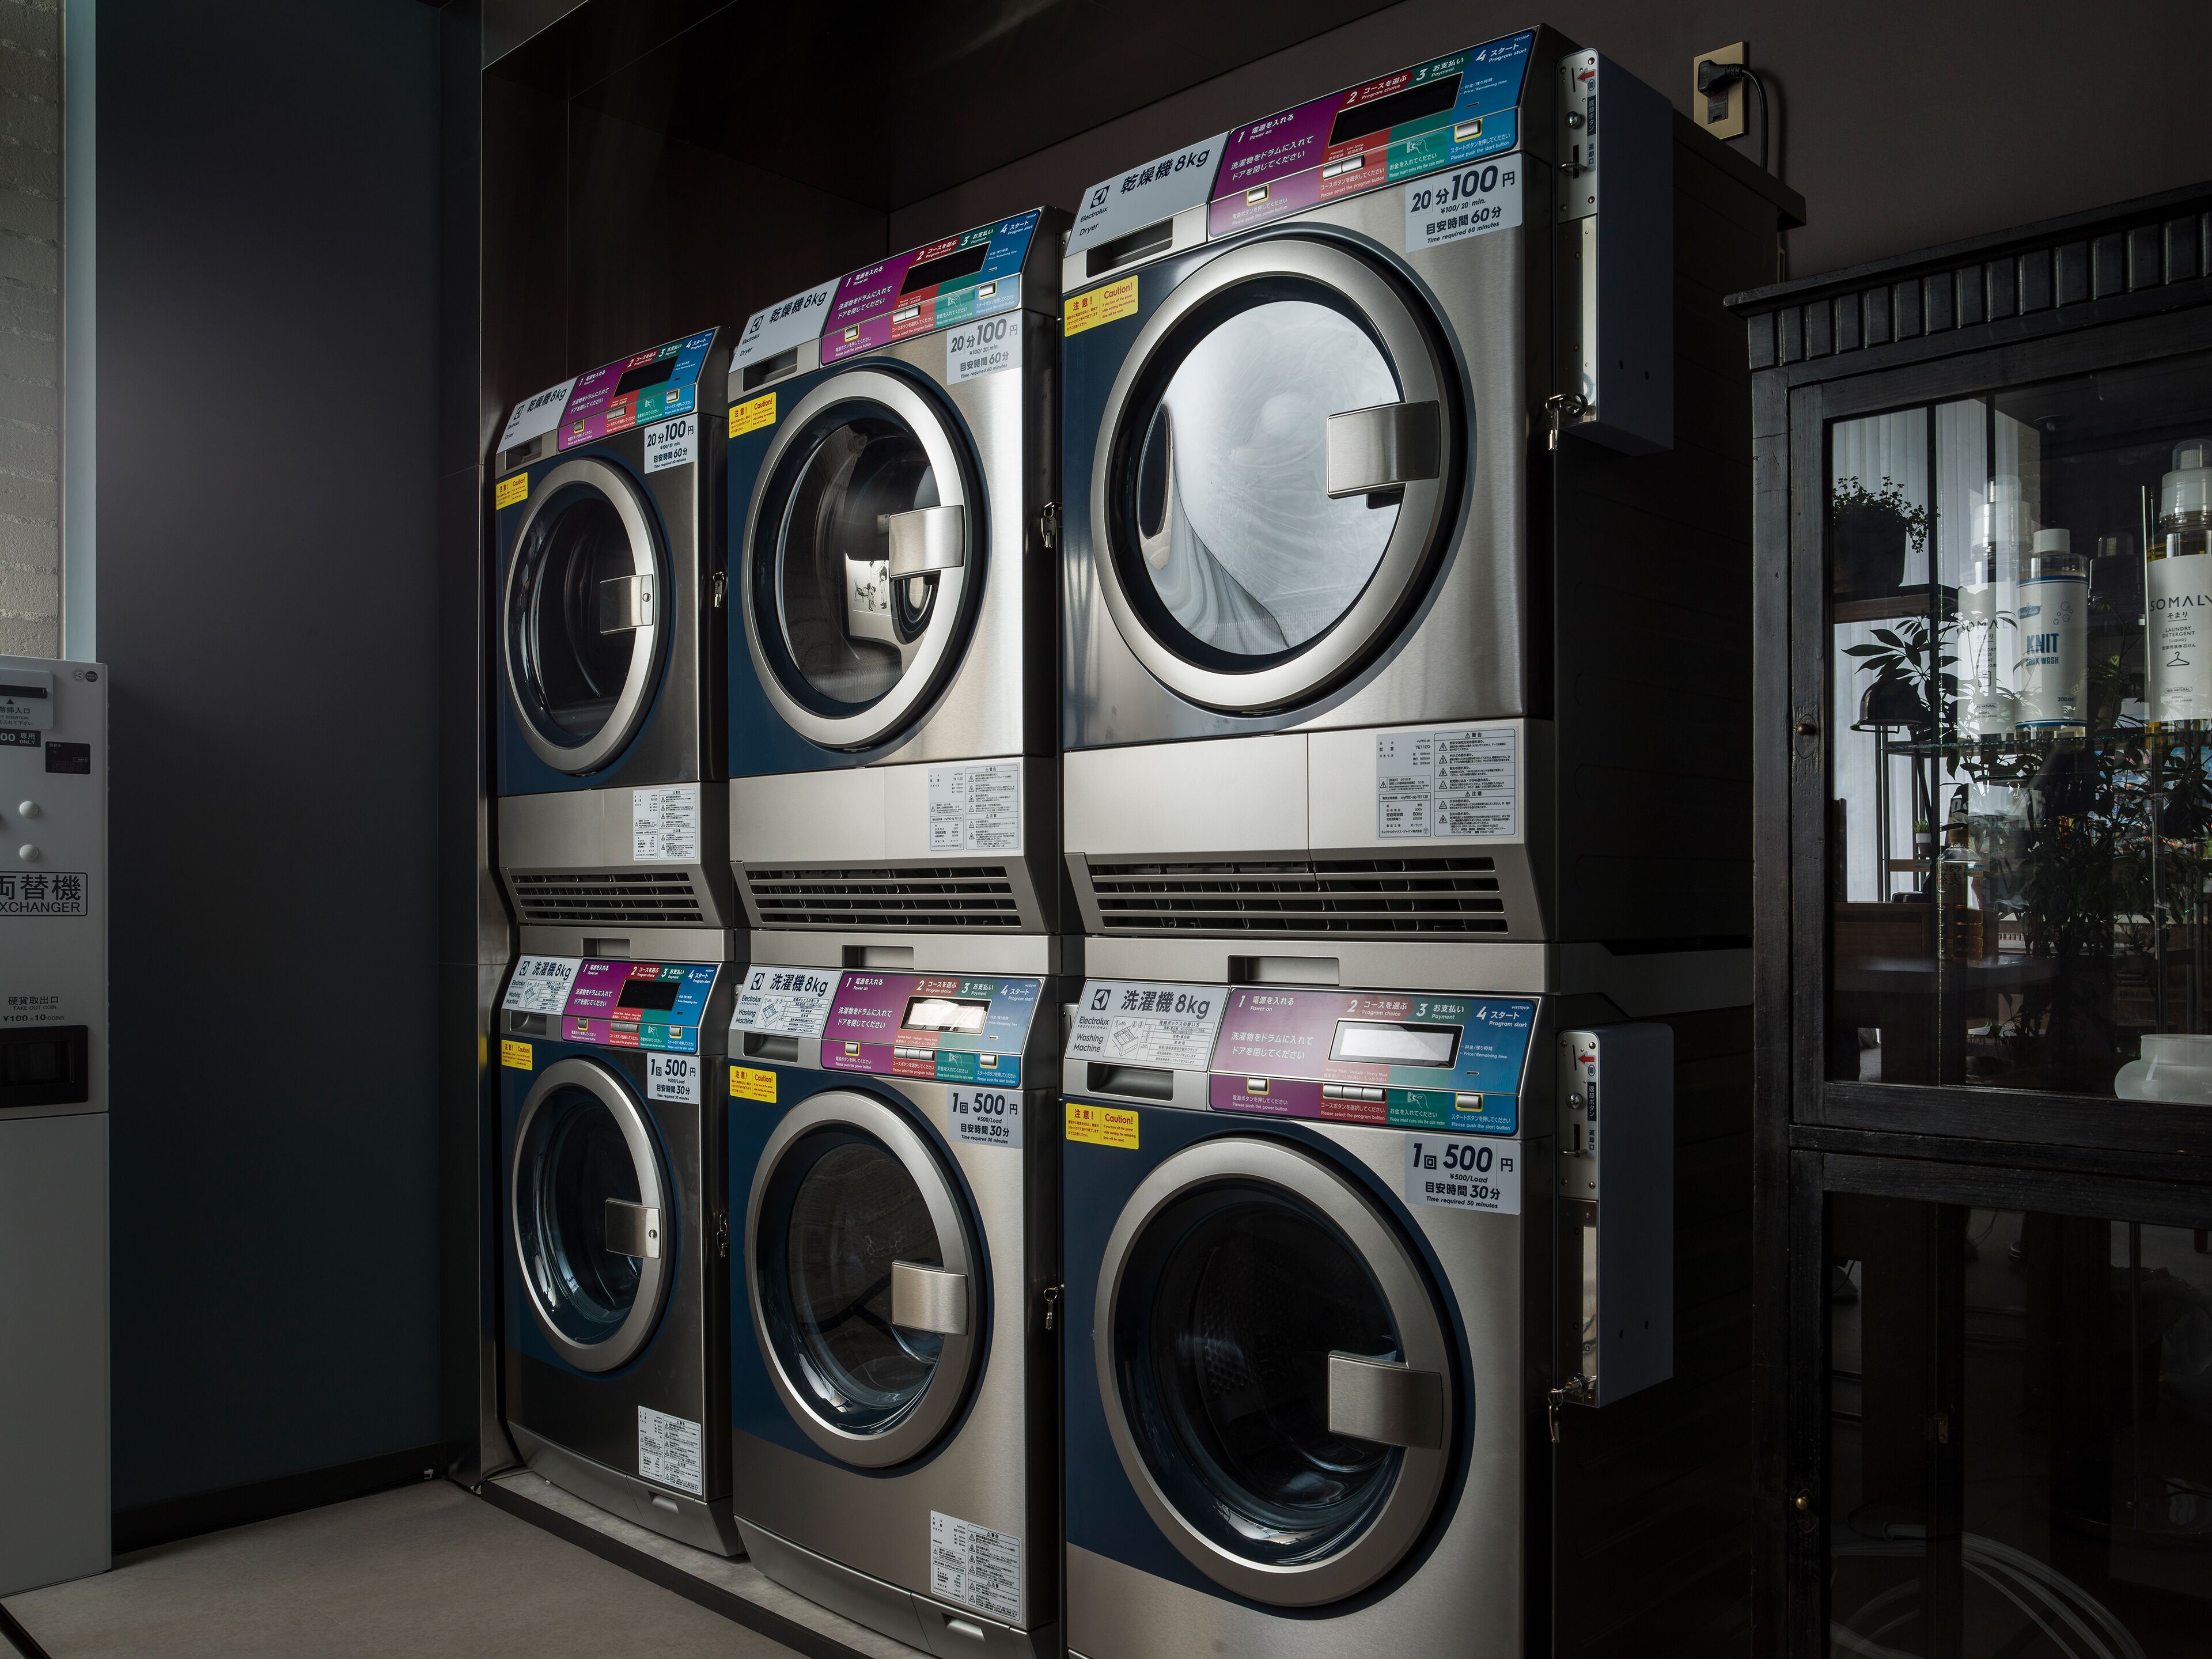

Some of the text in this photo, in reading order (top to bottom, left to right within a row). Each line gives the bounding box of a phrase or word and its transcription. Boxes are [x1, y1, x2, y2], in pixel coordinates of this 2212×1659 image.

[1476, 44, 1519, 62] 4 スタート
[1488, 48, 1527, 63] Program start
[1416, 58, 1464, 81] 3 お支払い
[1431, 67, 1455, 77] Payment
[1346, 74, 1408, 104] 2 コースを選ぶ
[1361, 84, 1400, 100] Program choice
[1238, 113, 1294, 143] 1 電源を入れる
[1249, 132, 1264, 141] Power
[1450, 133, 1510, 154] スタートボタンを押してください
[1230, 135, 1314, 170] 洗濯物をドラムに入れて
[1232, 150, 1305, 181] ドアを閉じてください
[1389, 153, 1437, 171] お金を入れてください
[1321, 168, 1384, 190] コースボタンを選択してください
[1354, 180, 1370, 190] program
[1080, 206, 1108, 222] Electrolux
[1000, 221, 1028, 233] 4 スタート
[1080, 223, 1099, 236] Dryer
[1442, 229, 1466, 240] required
[1477, 222, 1499, 230] minutes
[1104, 282, 1132, 298] Caution!
[838, 298, 885, 320] ドアを閉じてください
[742, 333, 760, 344] Electrolux
[740, 347, 753, 357] Dryer
[2027, 634, 2059, 654] KNIT
[20, 732, 35, 740] 専用
[916, 980, 925, 990] 2
[961, 983, 970, 994] 3
[1001, 985, 1009, 995] 4
[8, 996, 59, 1005] 硬貨取出口
[1238, 995, 1294, 1007] 1 電源を入れる
[1347, 1000, 1408, 1013] 2 コースを選ぶ
[738, 1009, 756, 1018] Washing
[838, 1007, 892, 1017] 洗濯物をドラムに入れて
[1416, 1003, 1464, 1016] 3 お支払い
[1476, 1006, 1487, 1020] 4
[838, 1018, 885, 1029] ドアを閉じてください
[1079, 1016, 1110, 1025] Electrolux
[1077, 1033, 1104, 1044] Washing
[1231, 1032, 1314, 1046] 洗濯物をドラムに入れて
[1073, 1043, 1101, 1052] Machine
[1232, 1046, 1305, 1059] ドアを閉じてください
[755, 1074, 773, 1083] Caution!
[1232, 1095, 1288, 1105] 電源ボタンを押してください
[1321, 1102, 1385, 1113] コースボタンを選択してください
[1390, 1108, 1437, 1118] お金を入れてください
[1105, 1113, 1133, 1124] Caution!
[1452, 1114, 1511, 1123] スタートボタンを押してください
